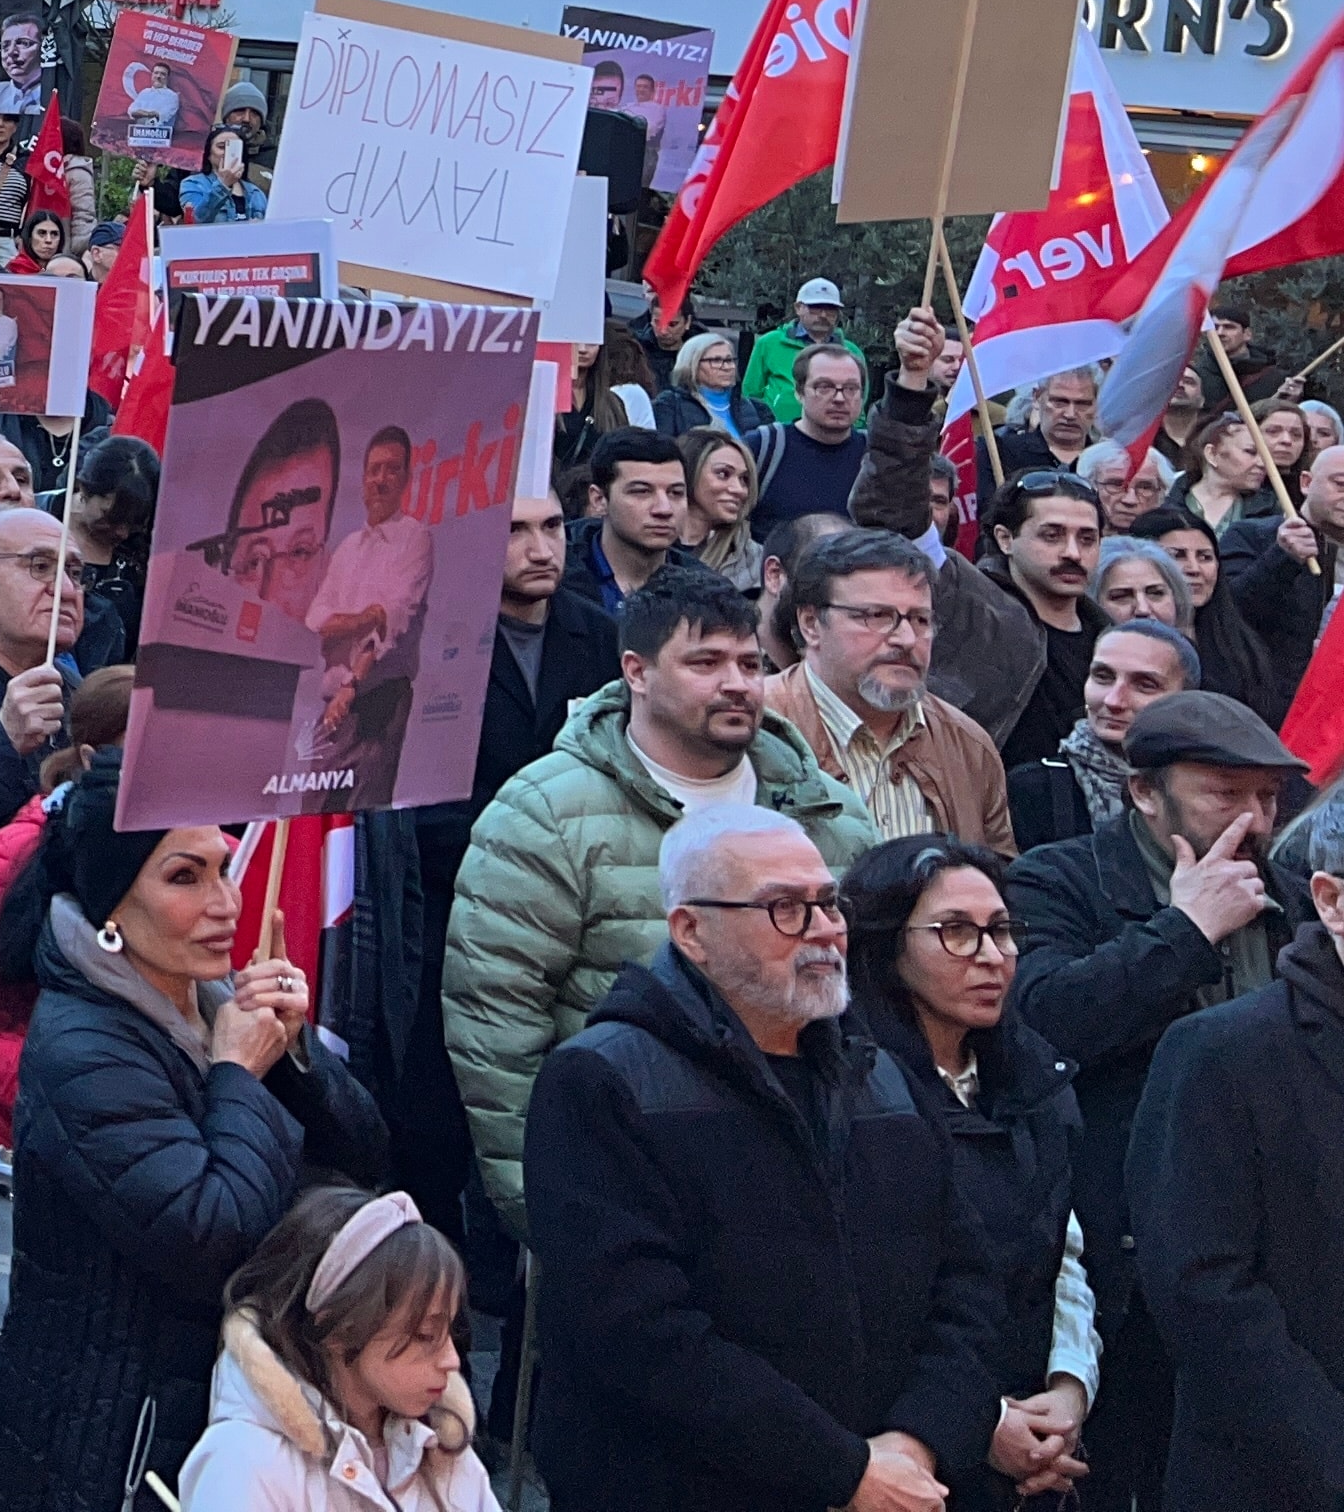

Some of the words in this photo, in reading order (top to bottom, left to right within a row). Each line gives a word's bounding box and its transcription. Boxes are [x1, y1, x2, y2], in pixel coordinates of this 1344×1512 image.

[562, 23, 709, 63] YANINDAYIZ!
[193, 292, 531, 354] YANINDAYIZ!
[261, 768, 355, 795] ALMANYA
